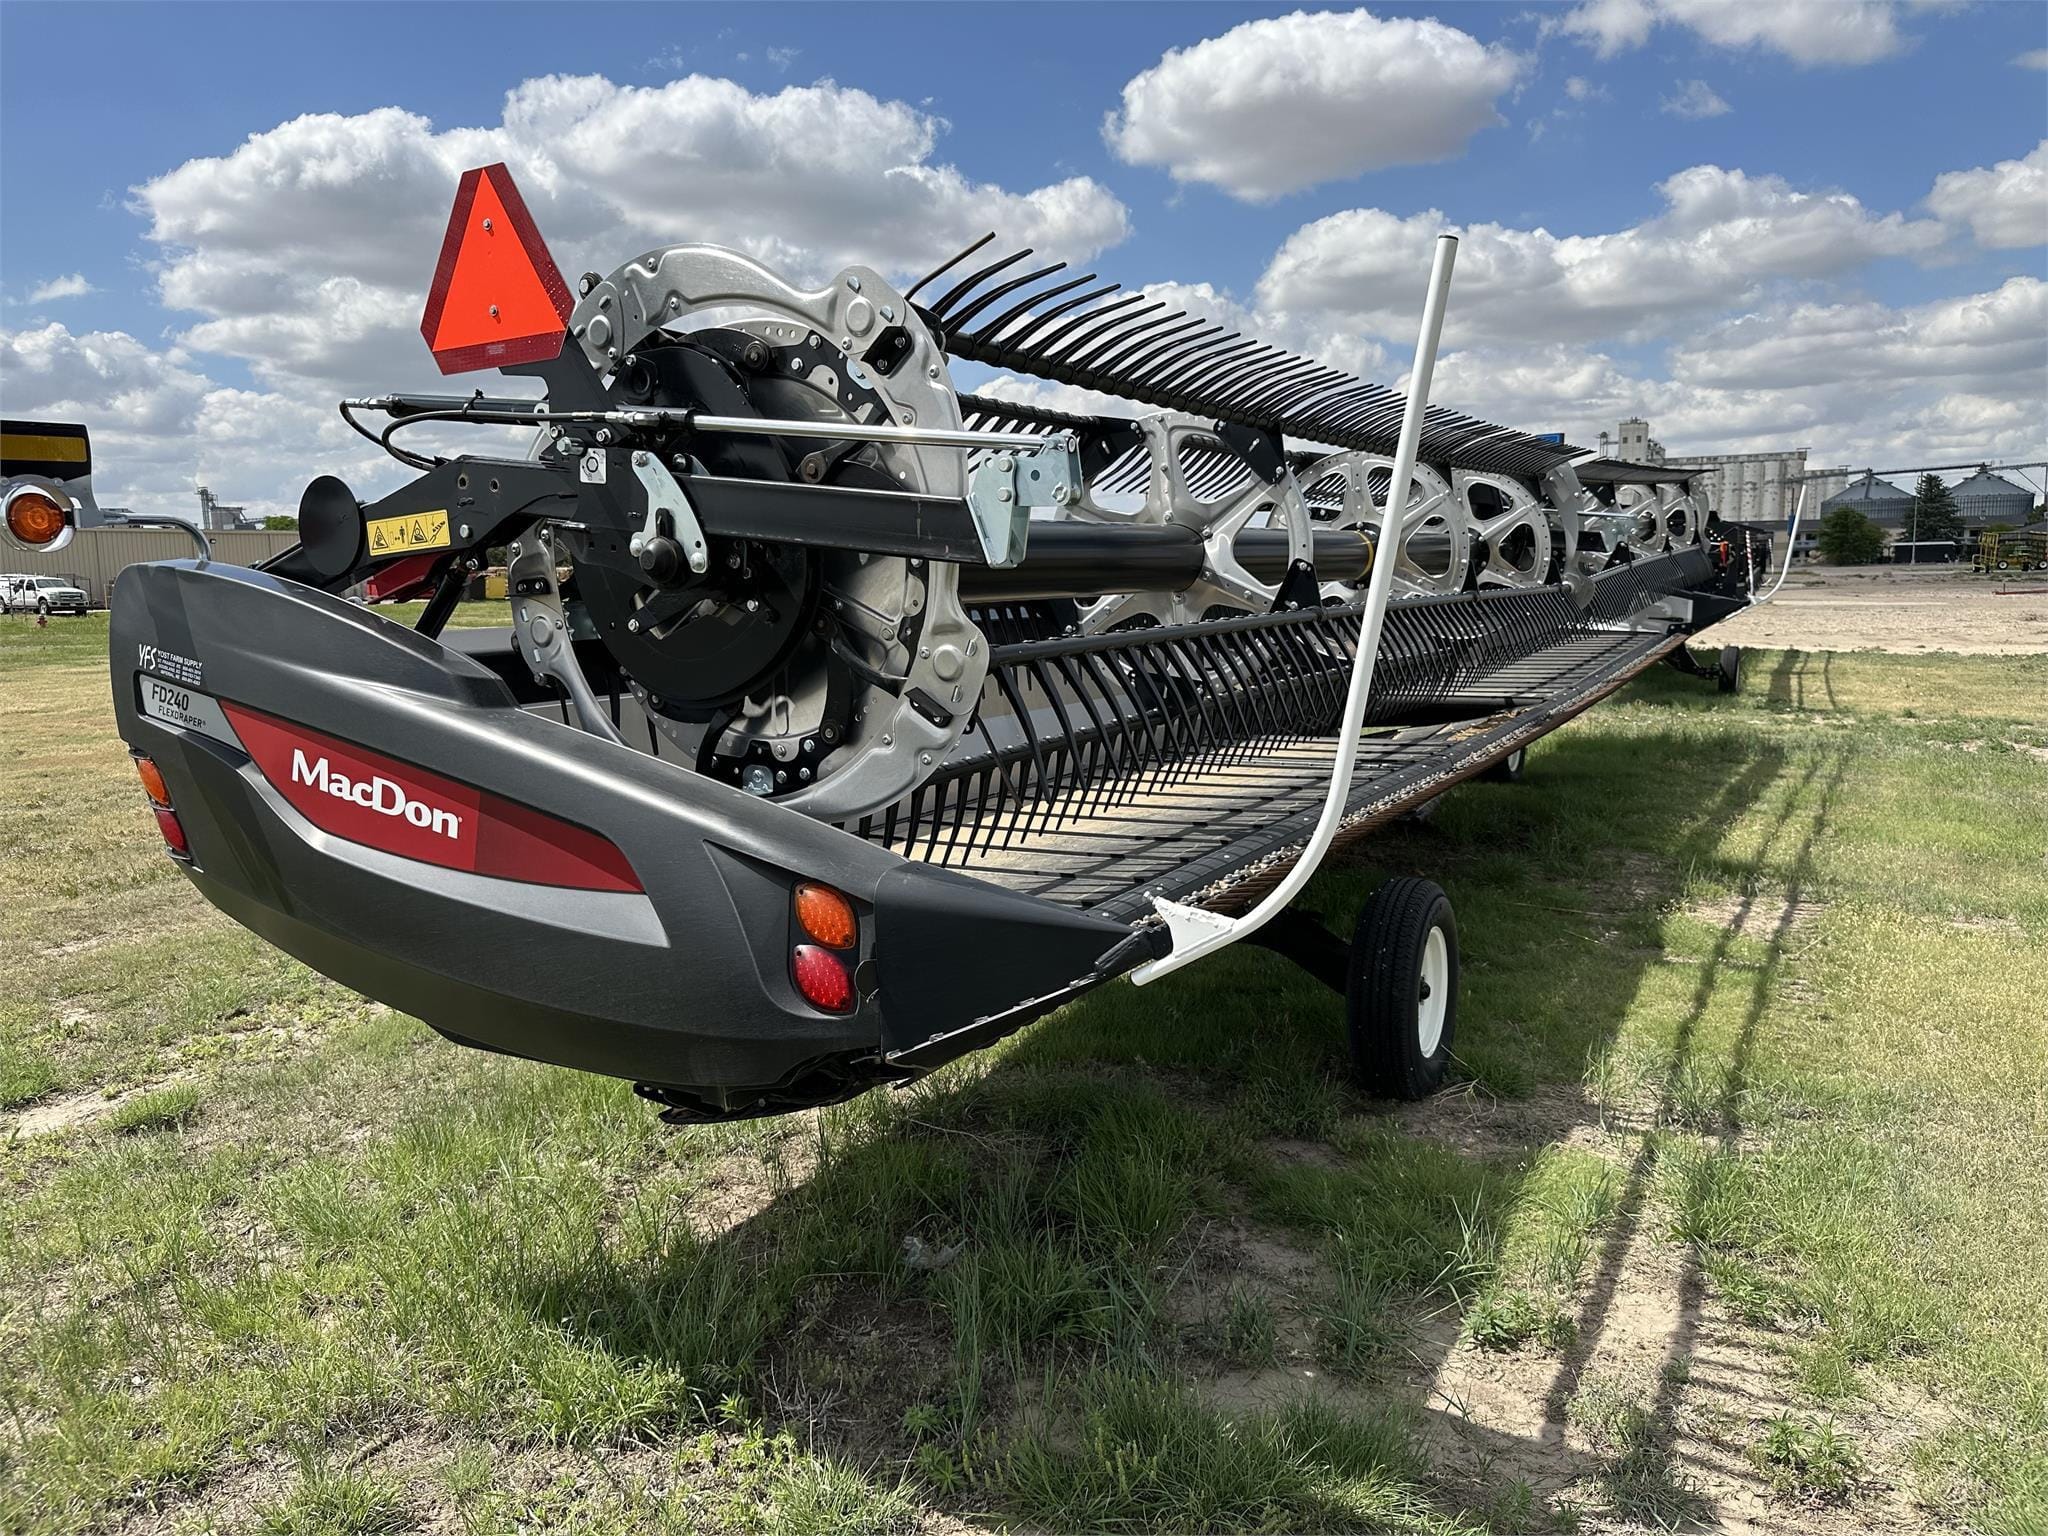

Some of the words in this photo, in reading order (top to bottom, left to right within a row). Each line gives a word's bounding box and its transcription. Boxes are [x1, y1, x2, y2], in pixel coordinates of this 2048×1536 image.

[138, 643, 157, 670] YFS
[157, 649, 171, 659] YOST
[170, 653, 184, 664] FARM
[183, 657, 203, 669] SUPPLY
[151, 682, 190, 711] FD240
[291, 748, 459, 840] MacDon
